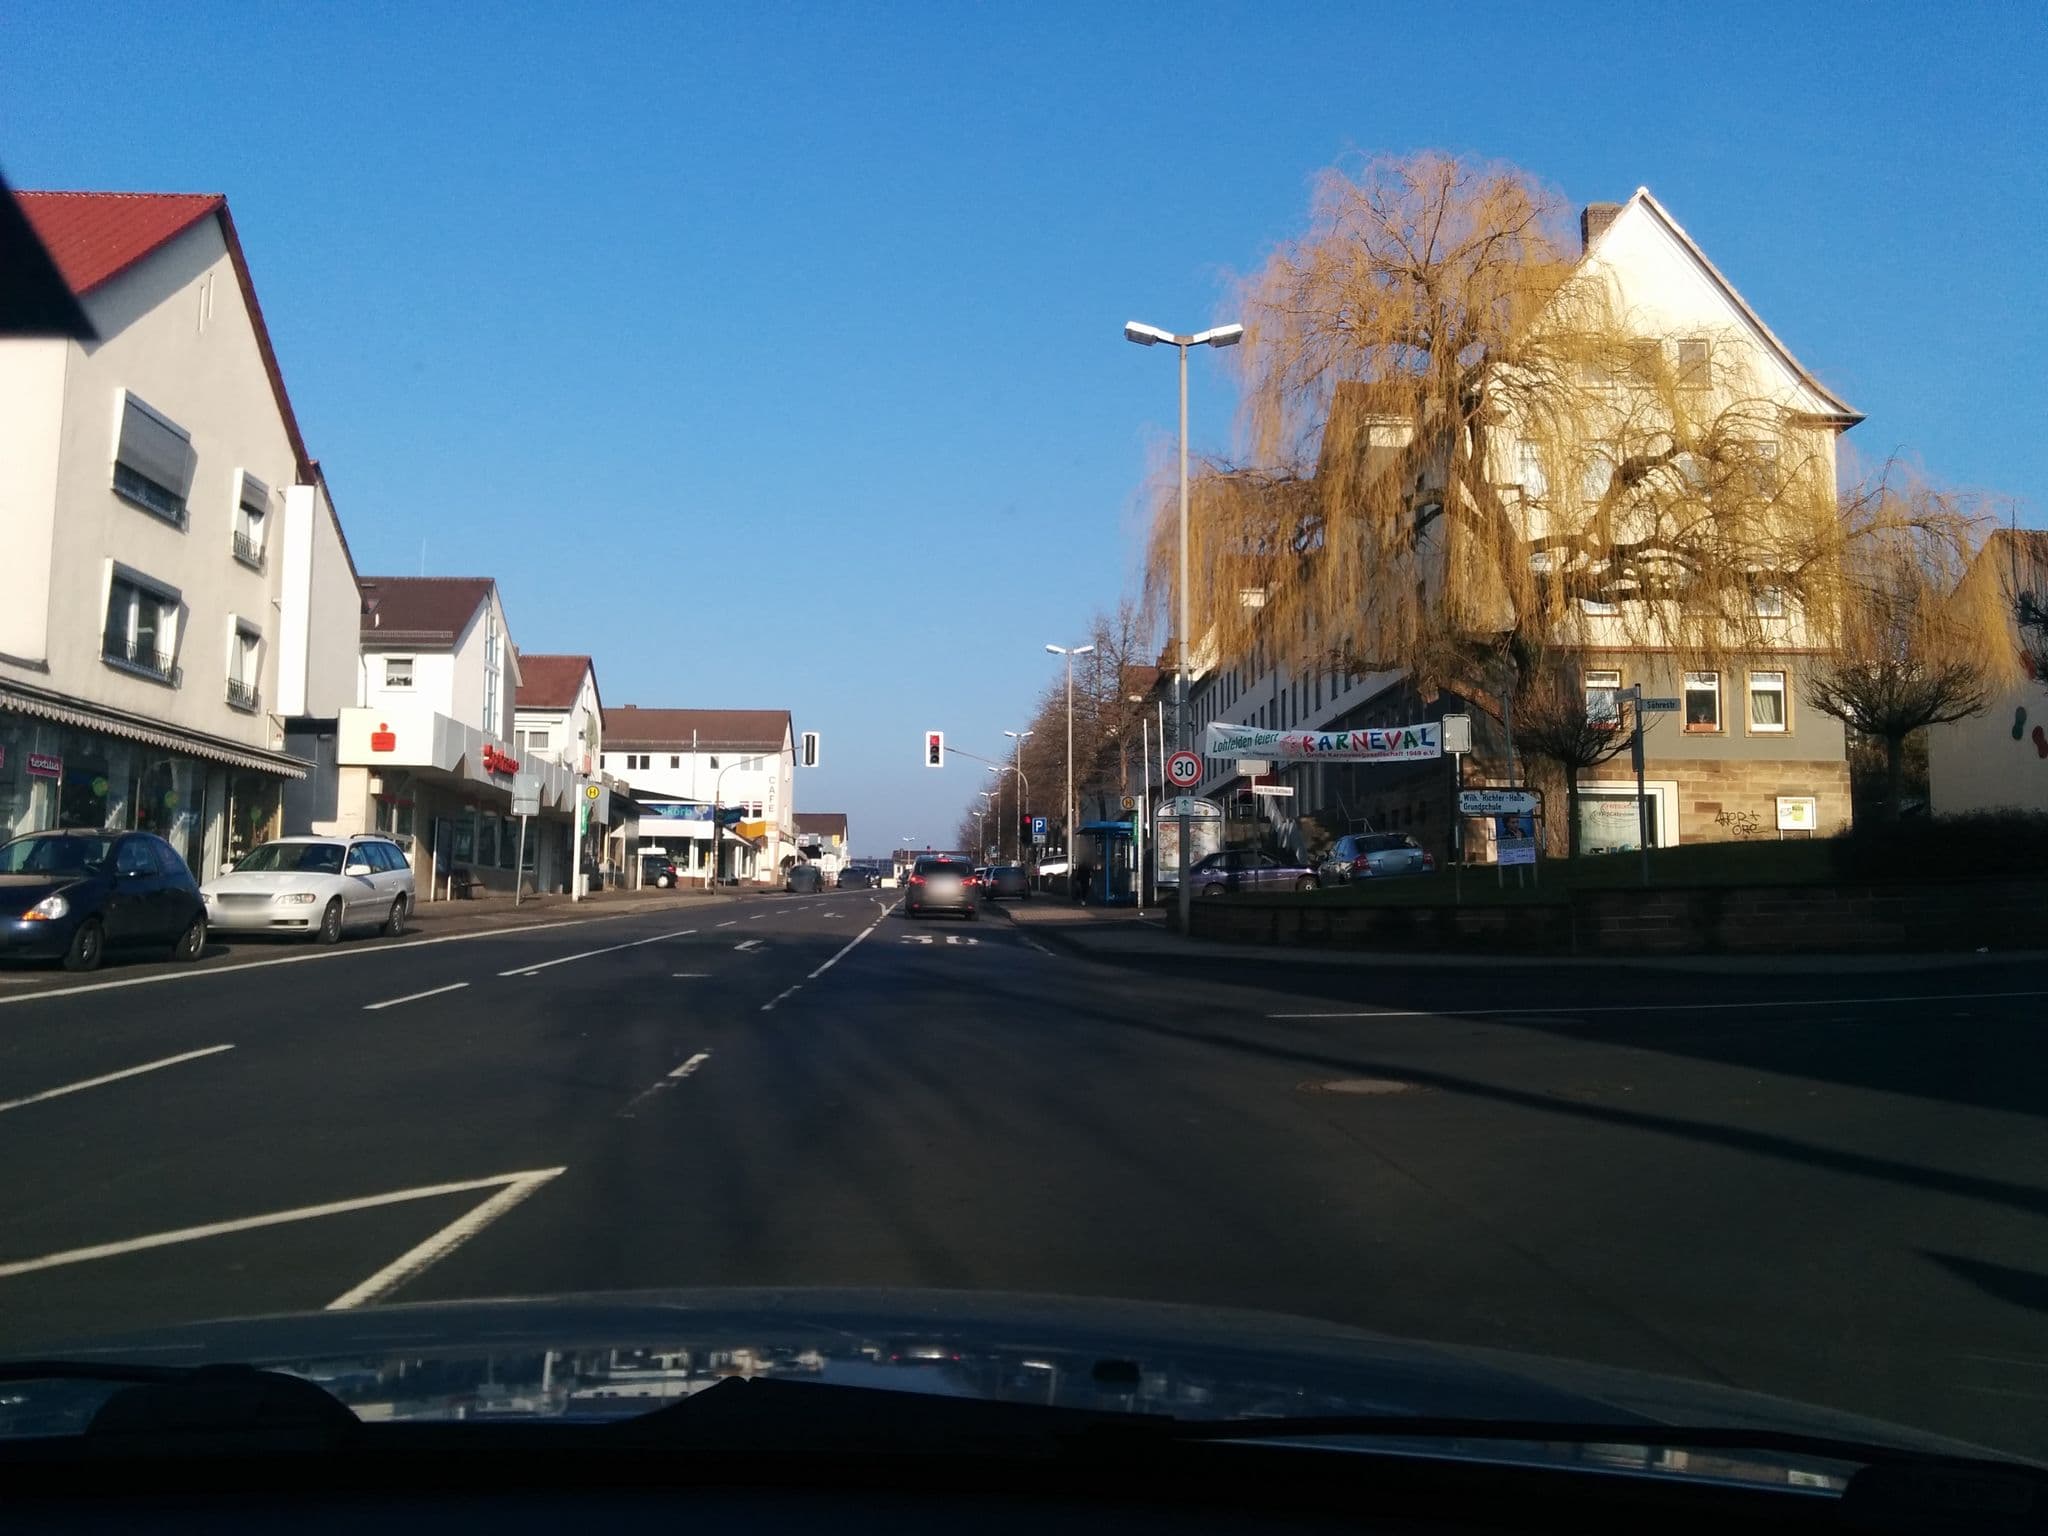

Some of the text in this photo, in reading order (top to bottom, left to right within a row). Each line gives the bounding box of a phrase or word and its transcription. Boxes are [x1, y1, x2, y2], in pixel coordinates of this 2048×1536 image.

[1213, 735, 1252, 753] Lohfelden
[1302, 728, 1435, 752] KARNEVAL
[1174, 761, 1195, 777] 30
[1035, 820, 1043, 833] P
